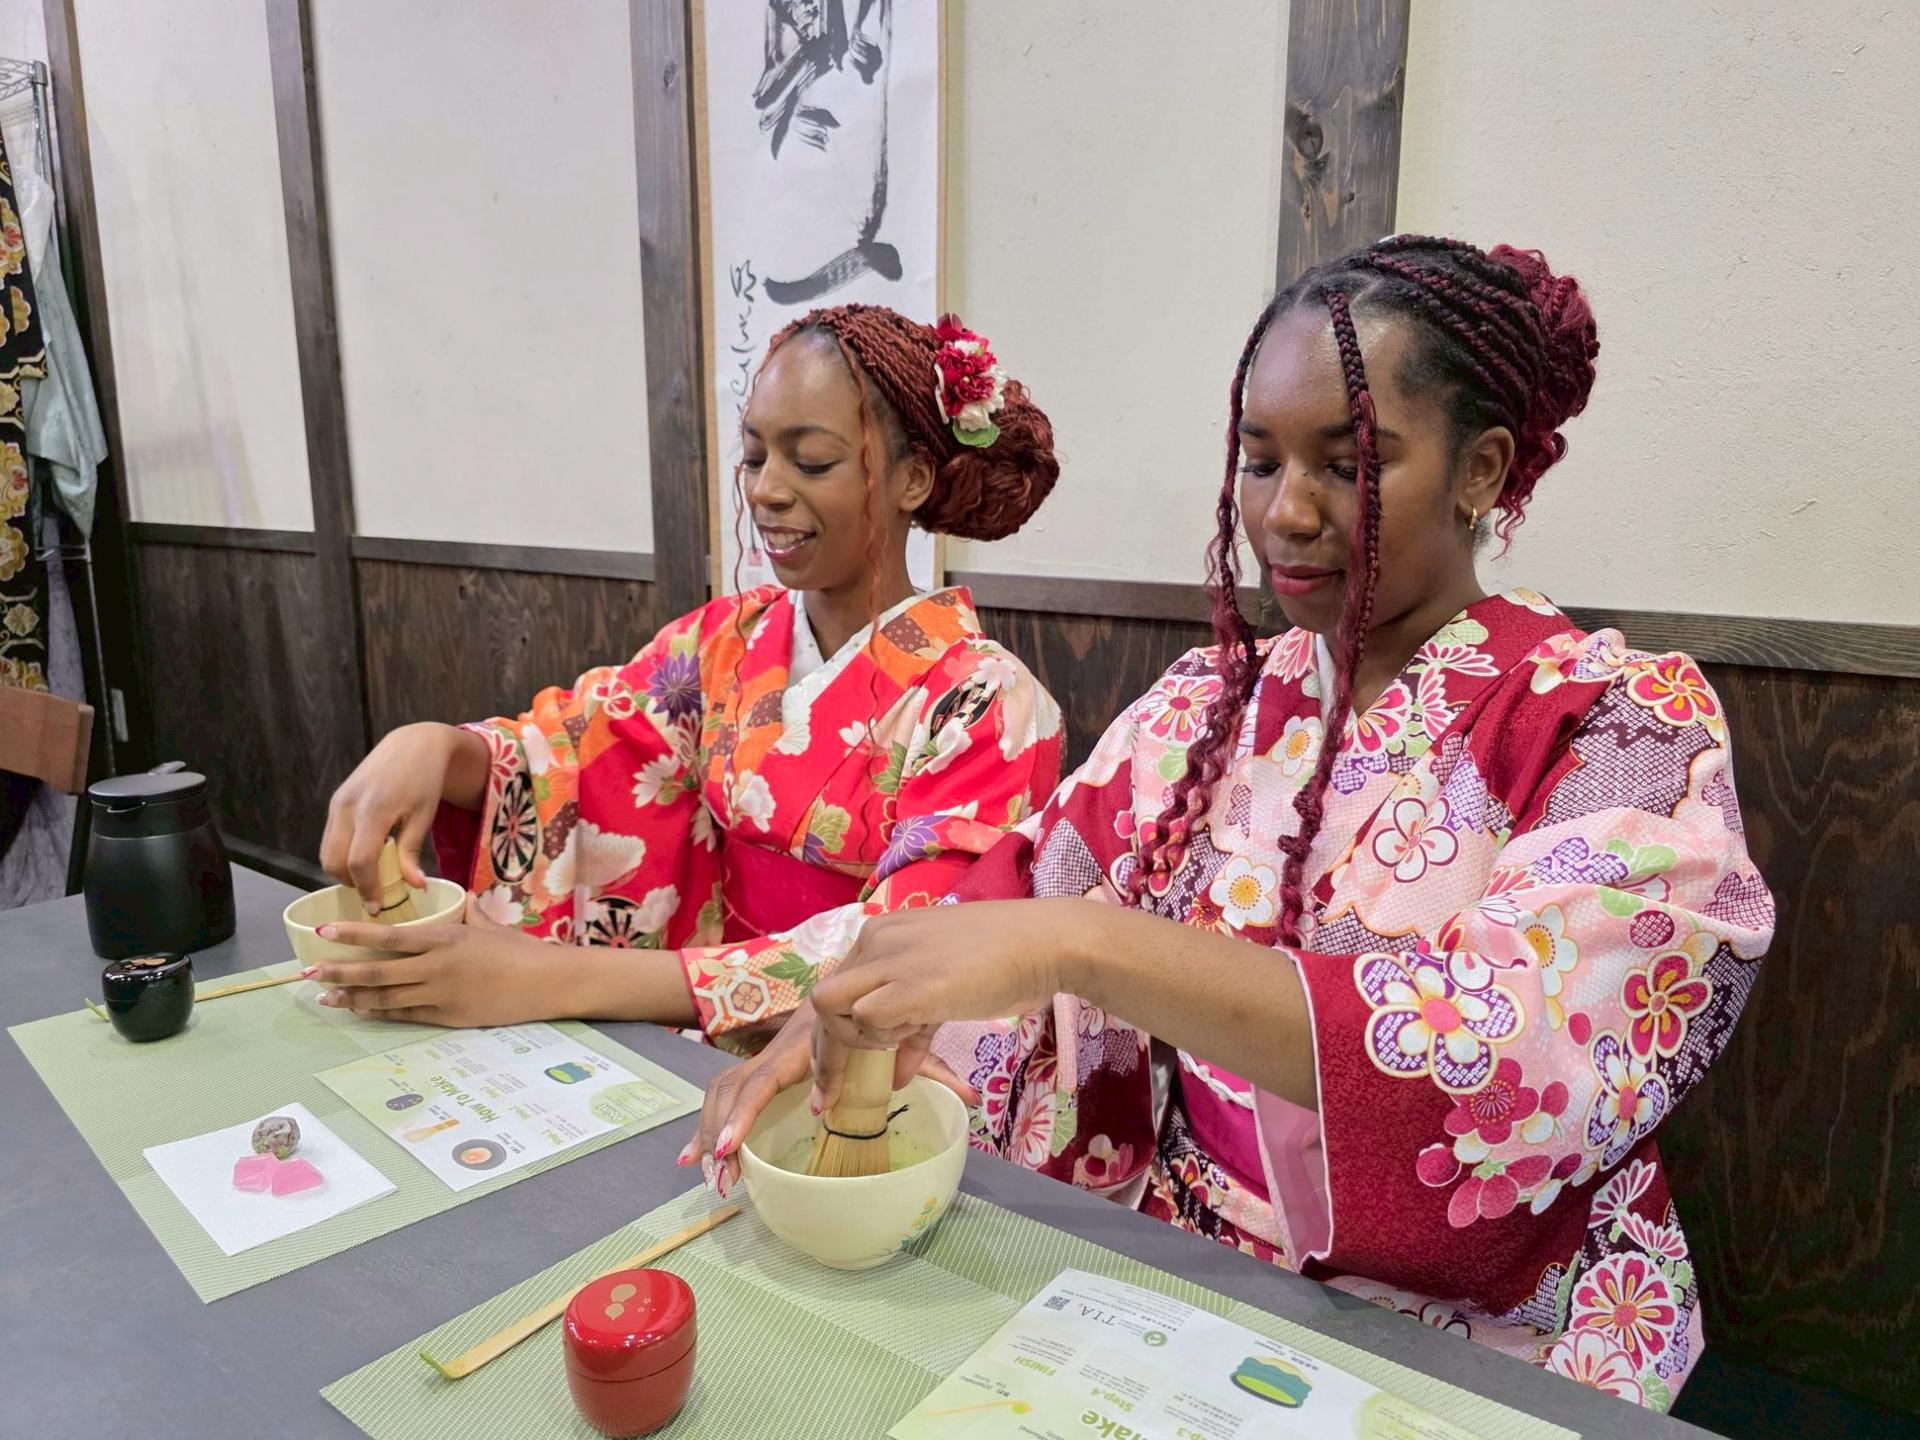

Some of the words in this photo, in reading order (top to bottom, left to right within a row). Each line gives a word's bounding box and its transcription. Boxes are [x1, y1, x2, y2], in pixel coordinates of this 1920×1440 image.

[430, 1075, 463, 1097] Make
[456, 1093, 475, 1108] To
[468, 1103, 501, 1124] How
[1080, 1305, 1117, 1327] TIA
[1013, 1355, 1057, 1377] FINISH
[1090, 1386, 1136, 1412] Step.4
[1081, 1409, 1148, 1440] ake
